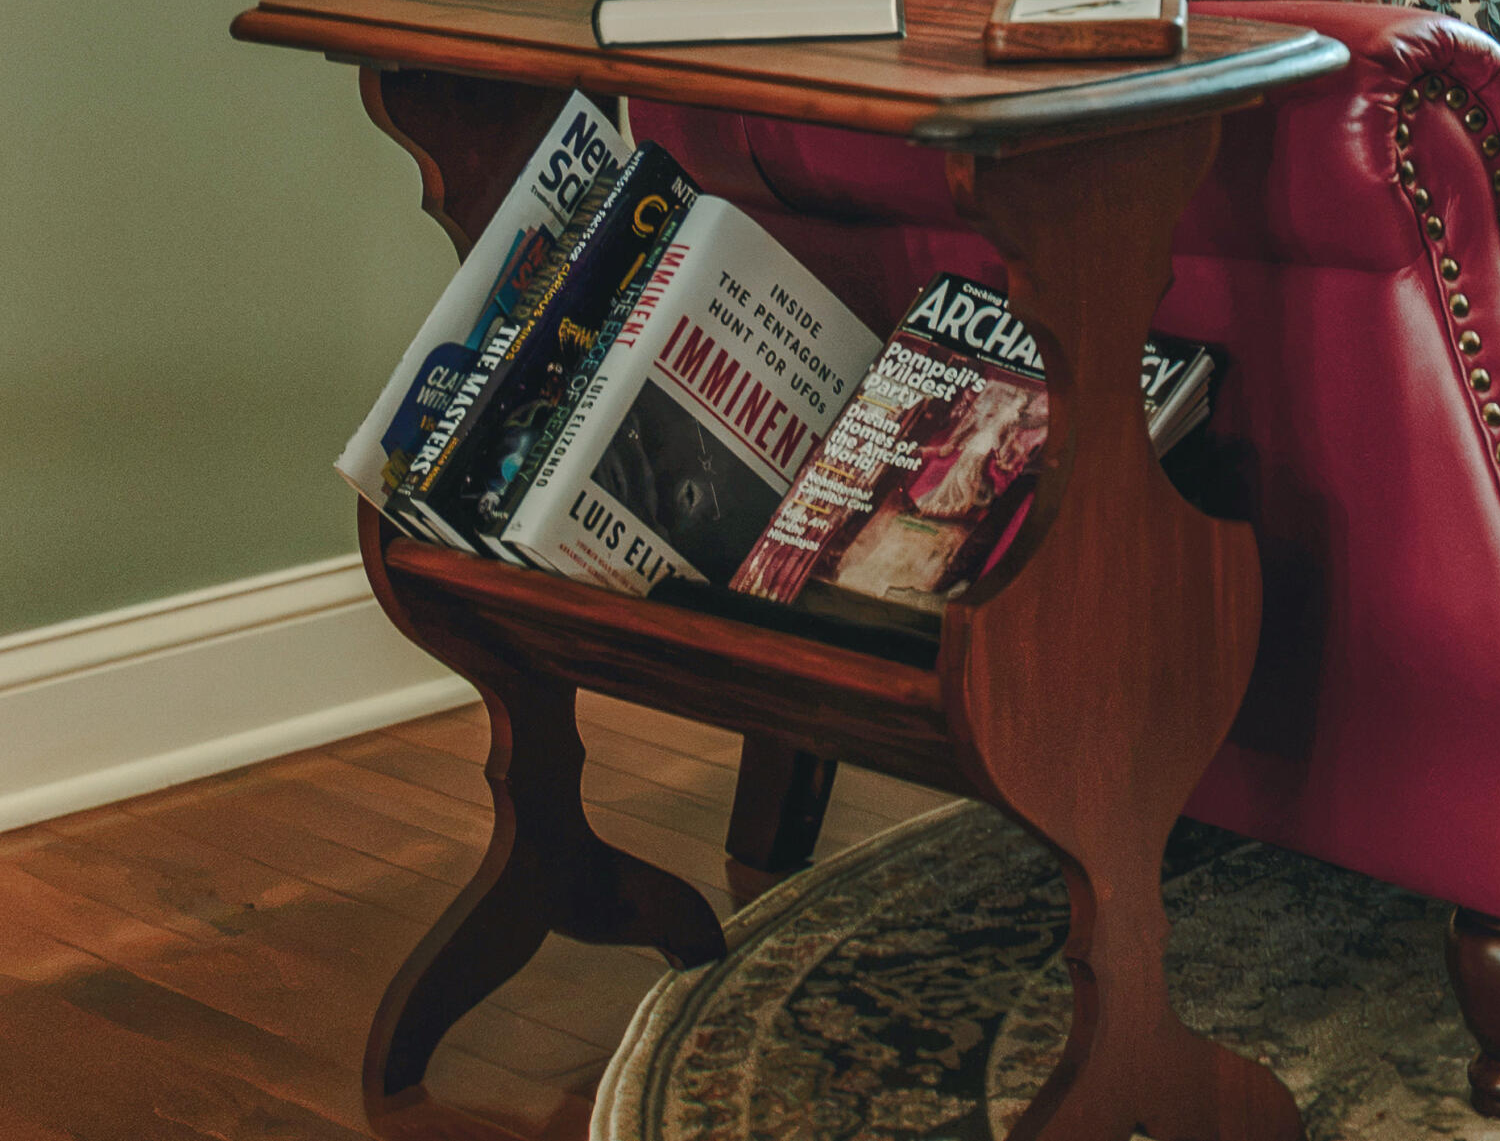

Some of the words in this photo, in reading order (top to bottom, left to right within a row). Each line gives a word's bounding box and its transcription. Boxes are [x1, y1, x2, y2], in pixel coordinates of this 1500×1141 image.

[615, 244, 690, 349] IMMINENT
[770, 283, 822, 339] INSIDE
[477, 323, 522, 371] THE
[708, 298, 754, 343] HUNT
[756, 341, 787, 376] FOR
[791, 373, 826, 414] UFOs
[719, 270, 751, 307] THE
[754, 303, 844, 395] PENTAGON'S
[579, 376, 608, 409] LUIS
[864, 373, 923, 410] Party
[877, 358, 957, 402] Wildest
[885, 342, 986, 393] Pompeii's
[410, 372, 489, 475] MASTERS
[839, 416, 895, 450] Homes
[896, 441, 918, 455] of
[846, 403, 900, 436] Dream
[535, 414, 585, 488] ELIZONDO
[857, 441, 922, 471] Ancient
[569, 490, 626, 550] LUIS
